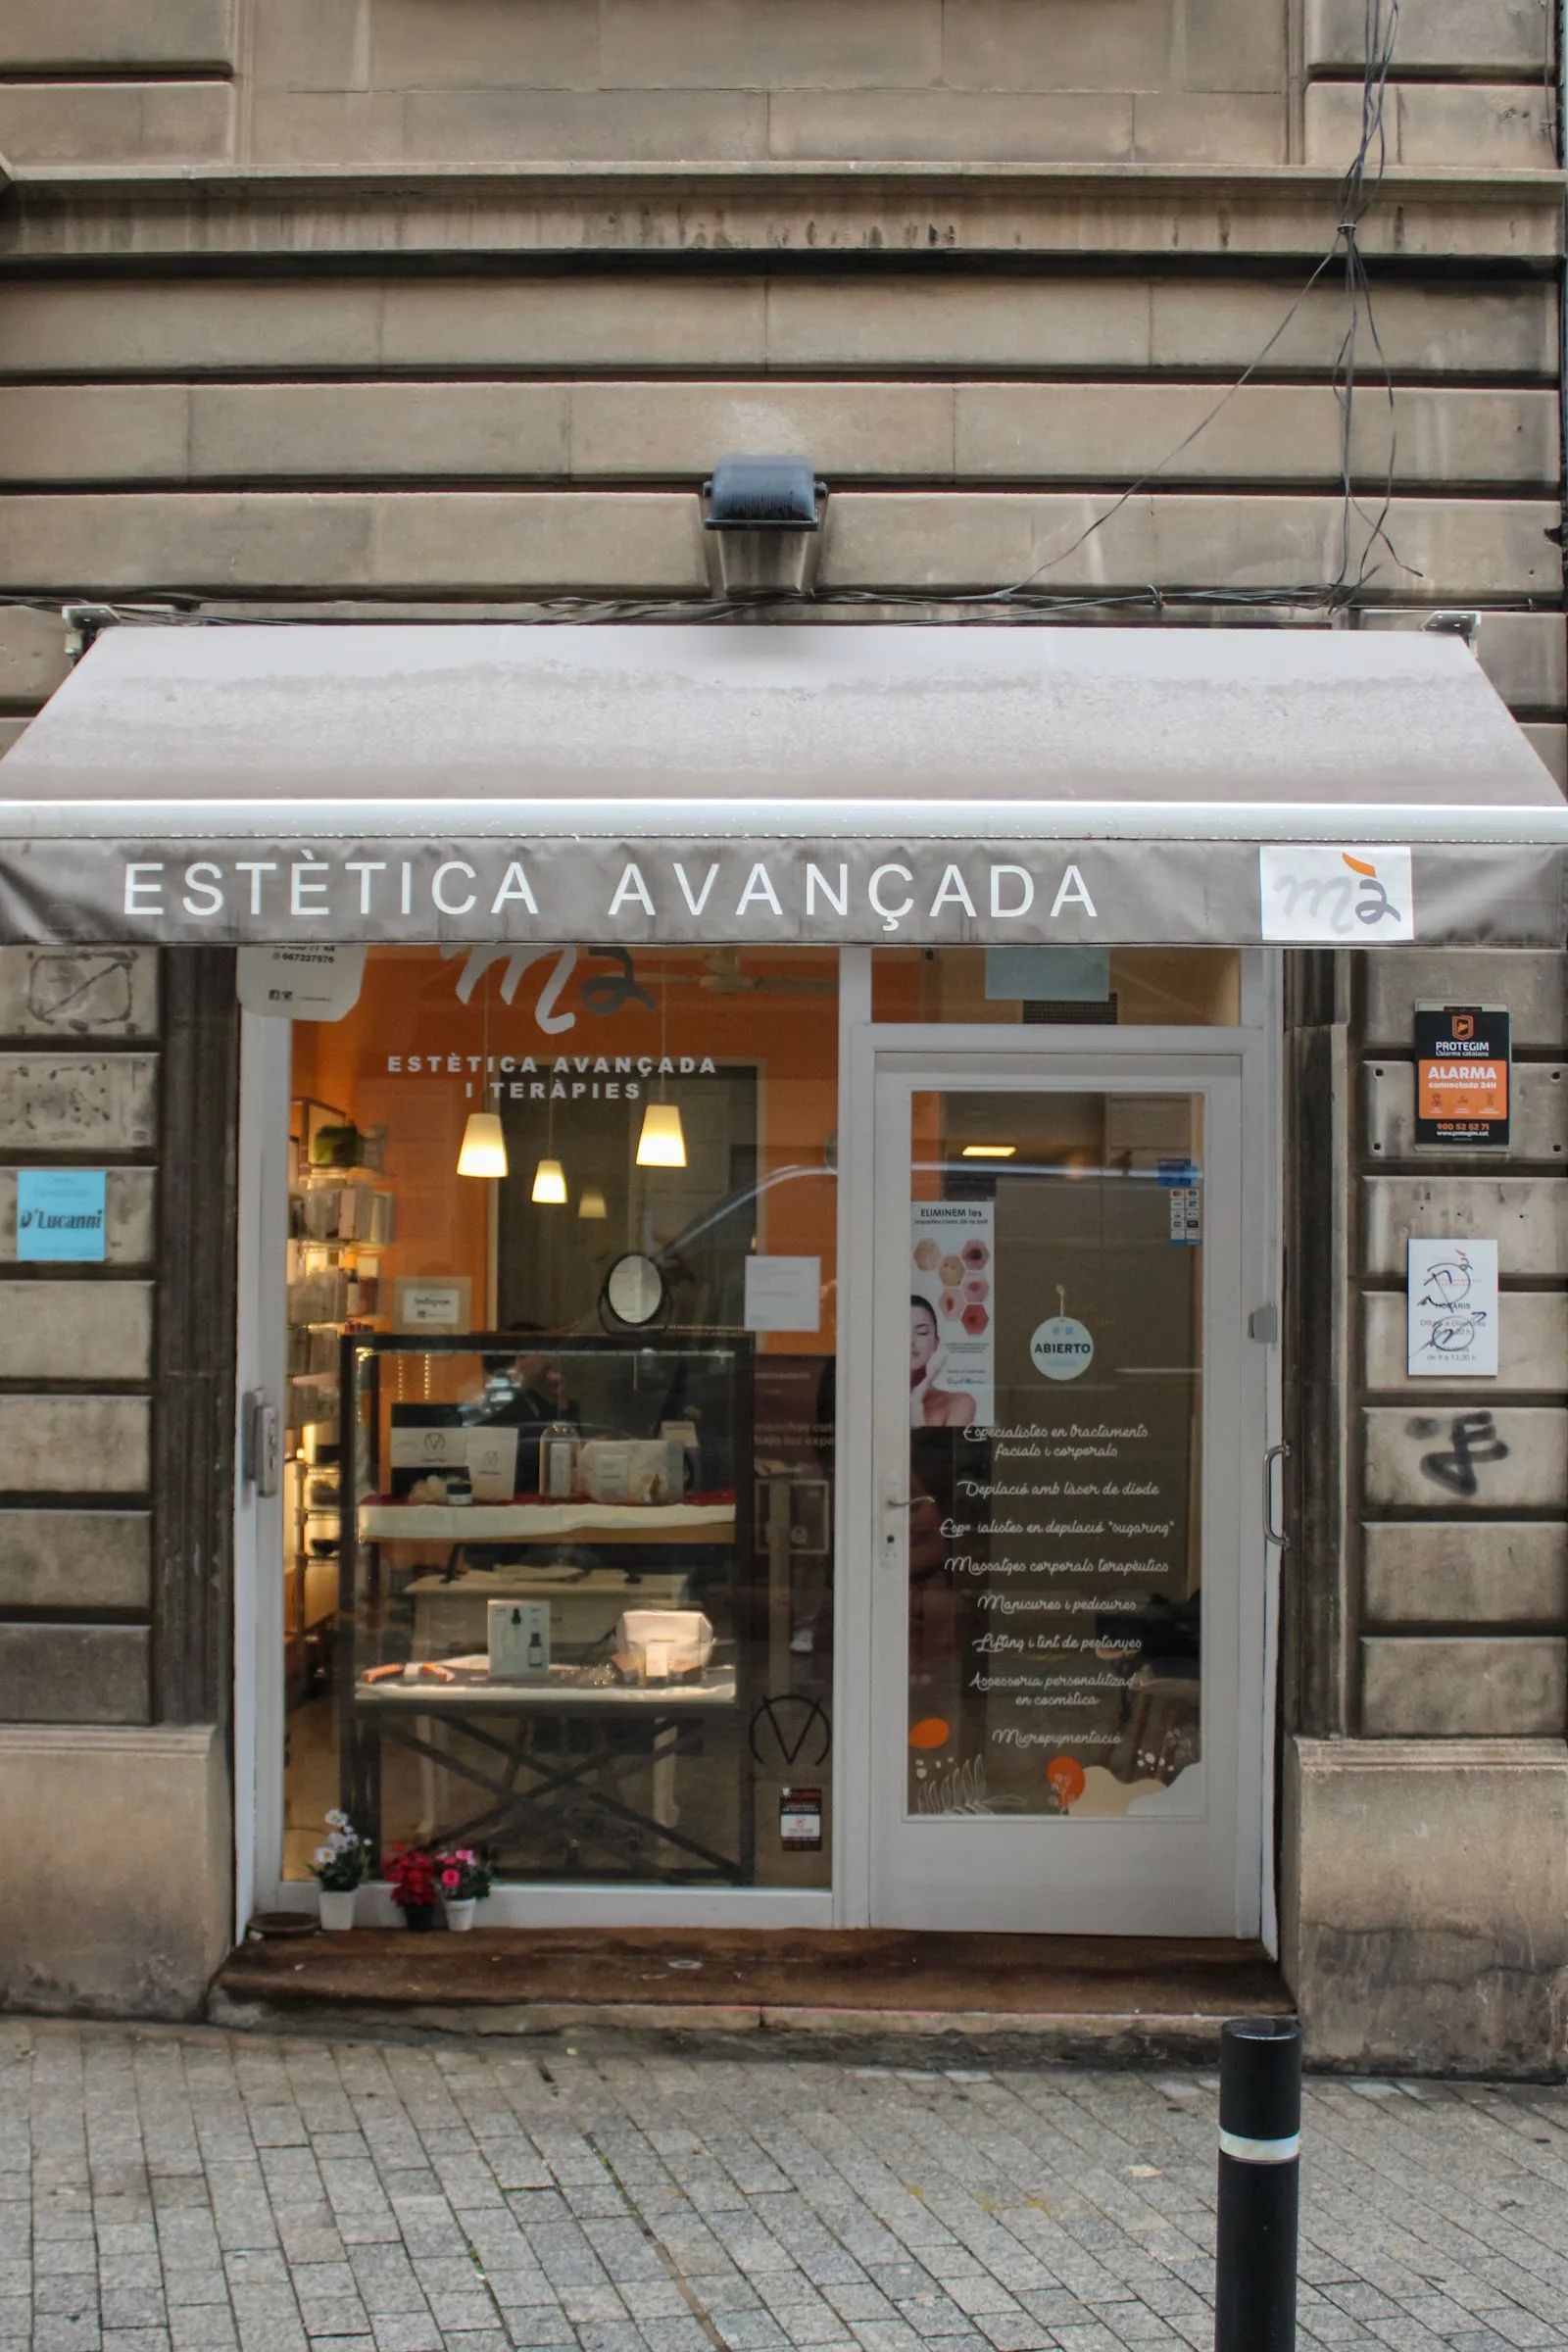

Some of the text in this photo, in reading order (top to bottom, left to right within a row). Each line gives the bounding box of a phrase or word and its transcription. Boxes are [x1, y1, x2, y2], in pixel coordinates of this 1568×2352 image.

[123, 850, 1098, 931] ESTÈTICA AVANÇADA
[1435, 1041, 1489, 1052] PROTEGIM
[387, 1053, 717, 1077] ESTÈTICA AVANÇADA
[1428, 1066, 1497, 1079] ALARMA
[466, 1079, 640, 1099] I TERÀPIES
[920, 1208, 966, 1217] ELIMINEM
[1034, 1344, 1091, 1353] ABIERTO
[962, 1423, 1149, 1442] Especialistes en tractaments
[995, 1443, 1041, 1460] facials
[1054, 1443, 1118, 1460] corporals
[956, 1481, 1029, 1498] Depilació
[1032, 1481, 1060, 1494] amb
[1063, 1481, 1100, 1494] làser
[1102, 1481, 1119, 1494] de
[940, 1519, 1023, 1538] Espeialistes
[1026, 1522, 1043, 1534] en
[1046, 1519, 1105, 1537] depilació
[944, 1555, 1169, 1576] Massatges corporals terapèutics
[977, 1594, 1061, 1614] Manicures
[1072, 1596, 1137, 1614] pedicures
[971, 1633, 1024, 1652] Lifting
[1036, 1634, 1060, 1648] tint
[1062, 1634, 1079, 1648] de
[1080, 1635, 1142, 1653] pestanyes
[968, 1672, 1043, 1690] Assessoria
[1015, 1691, 1100, 1705] en cosmètica
[992, 1728, 1122, 1748] Micropigmentació
